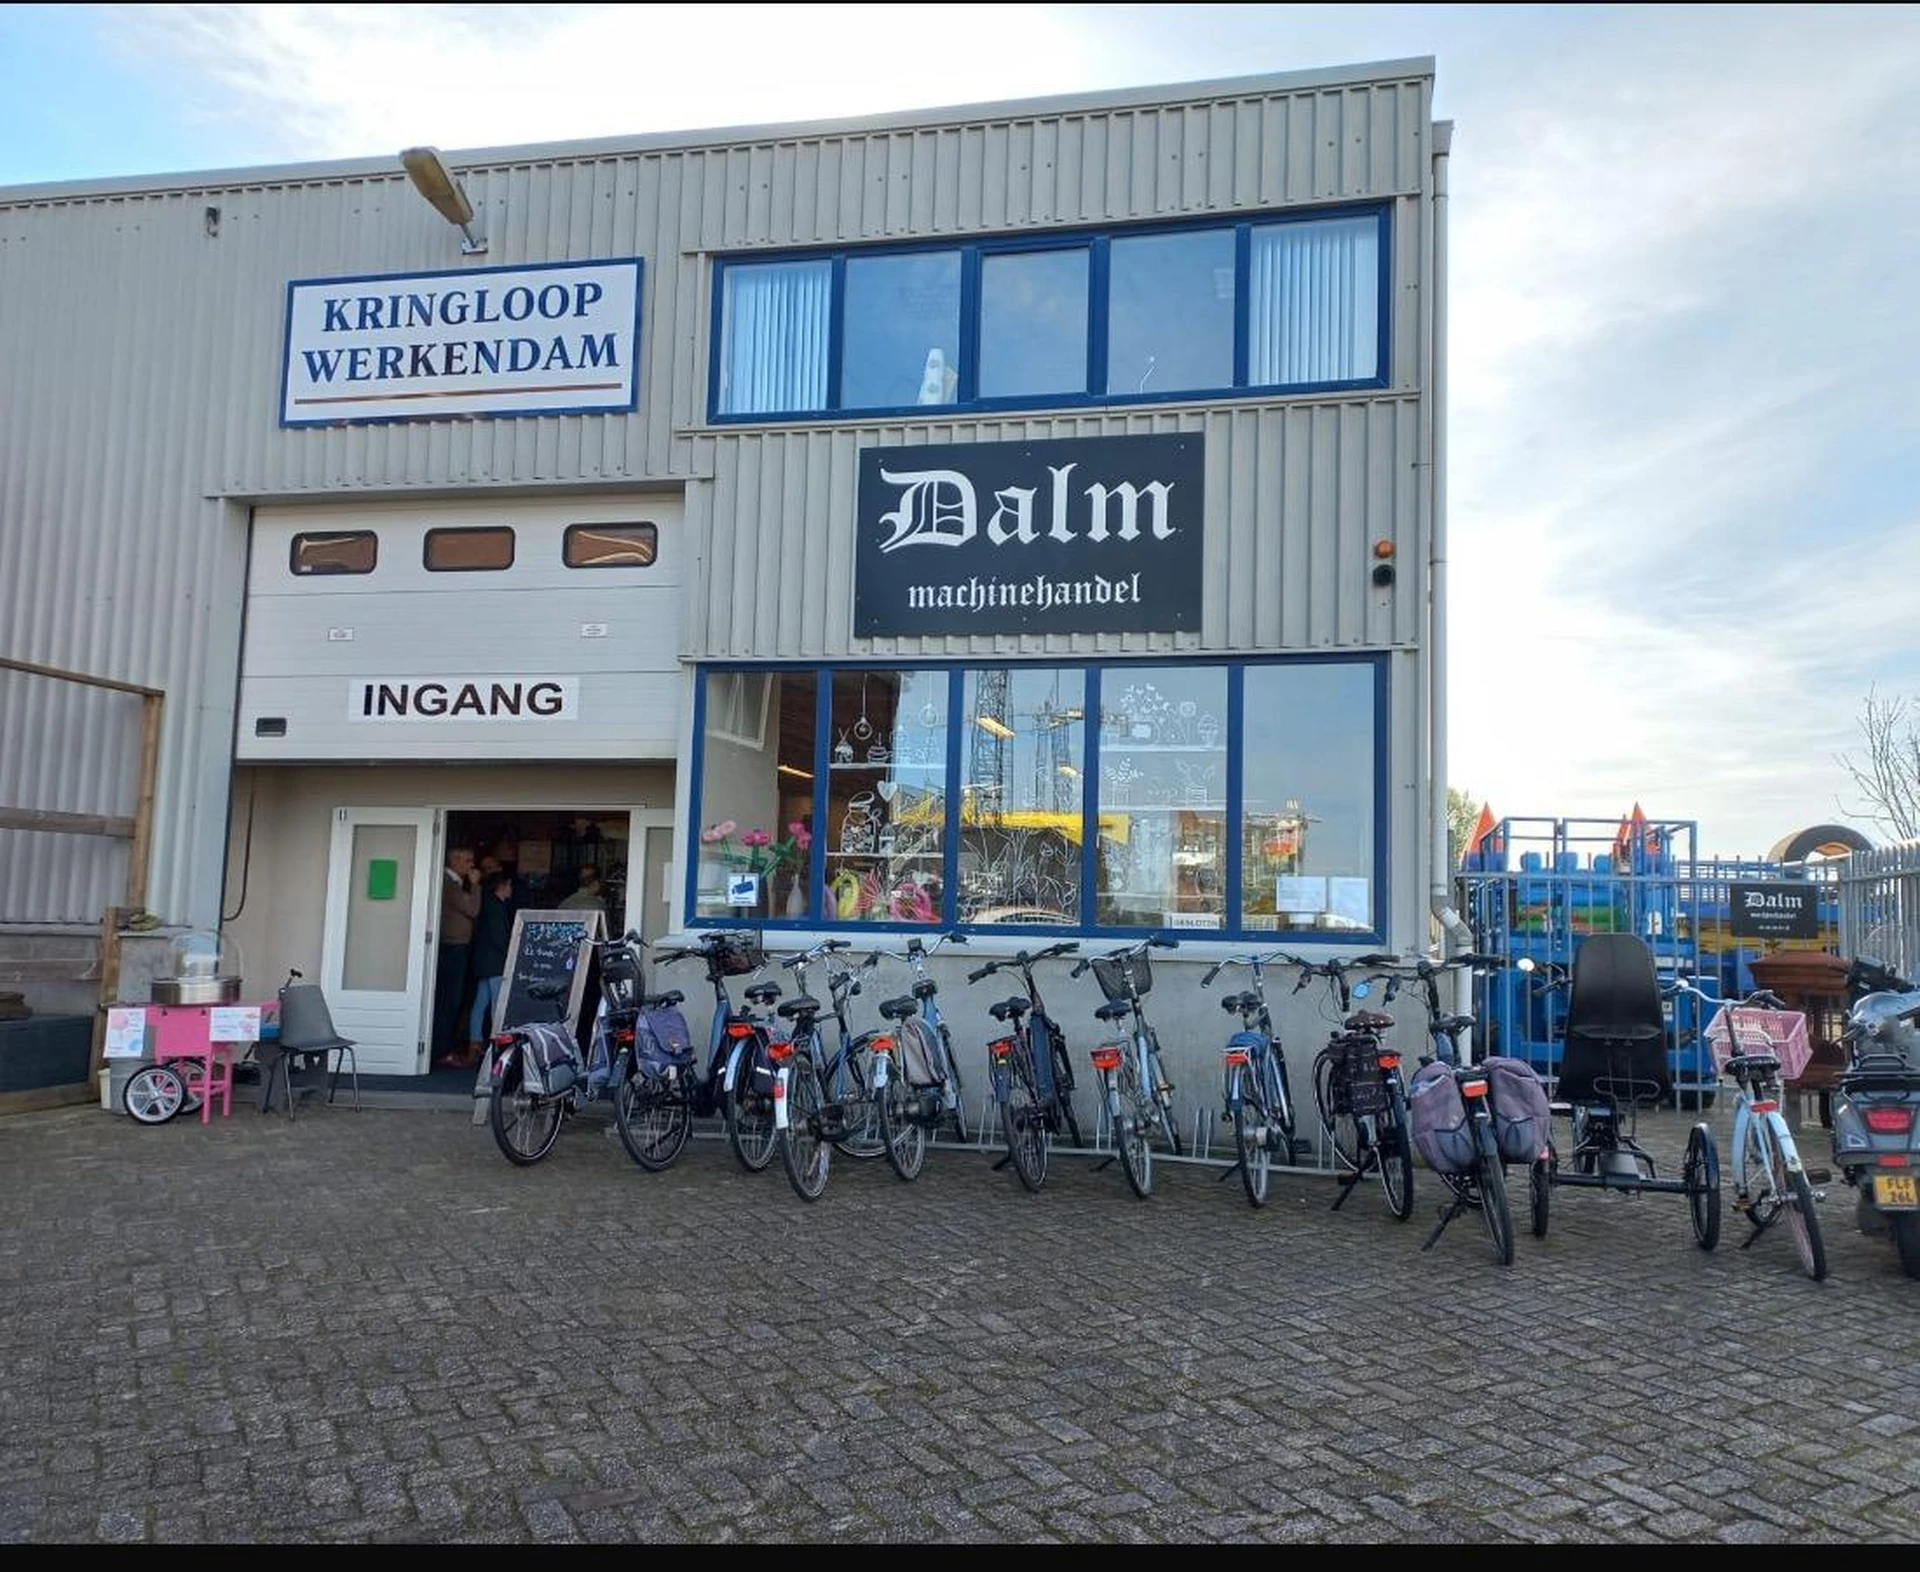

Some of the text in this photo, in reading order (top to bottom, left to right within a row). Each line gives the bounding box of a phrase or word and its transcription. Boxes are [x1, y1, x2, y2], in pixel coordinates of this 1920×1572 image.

[321, 282, 603, 332] KRINGLOOP
[301, 333, 620, 383] WERKENDAM
[878, 463, 1177, 553] Dalm
[908, 572, 1142, 612] machinehandel
[363, 682, 564, 716] INGANG
[1744, 891, 1803, 908] Dalm
